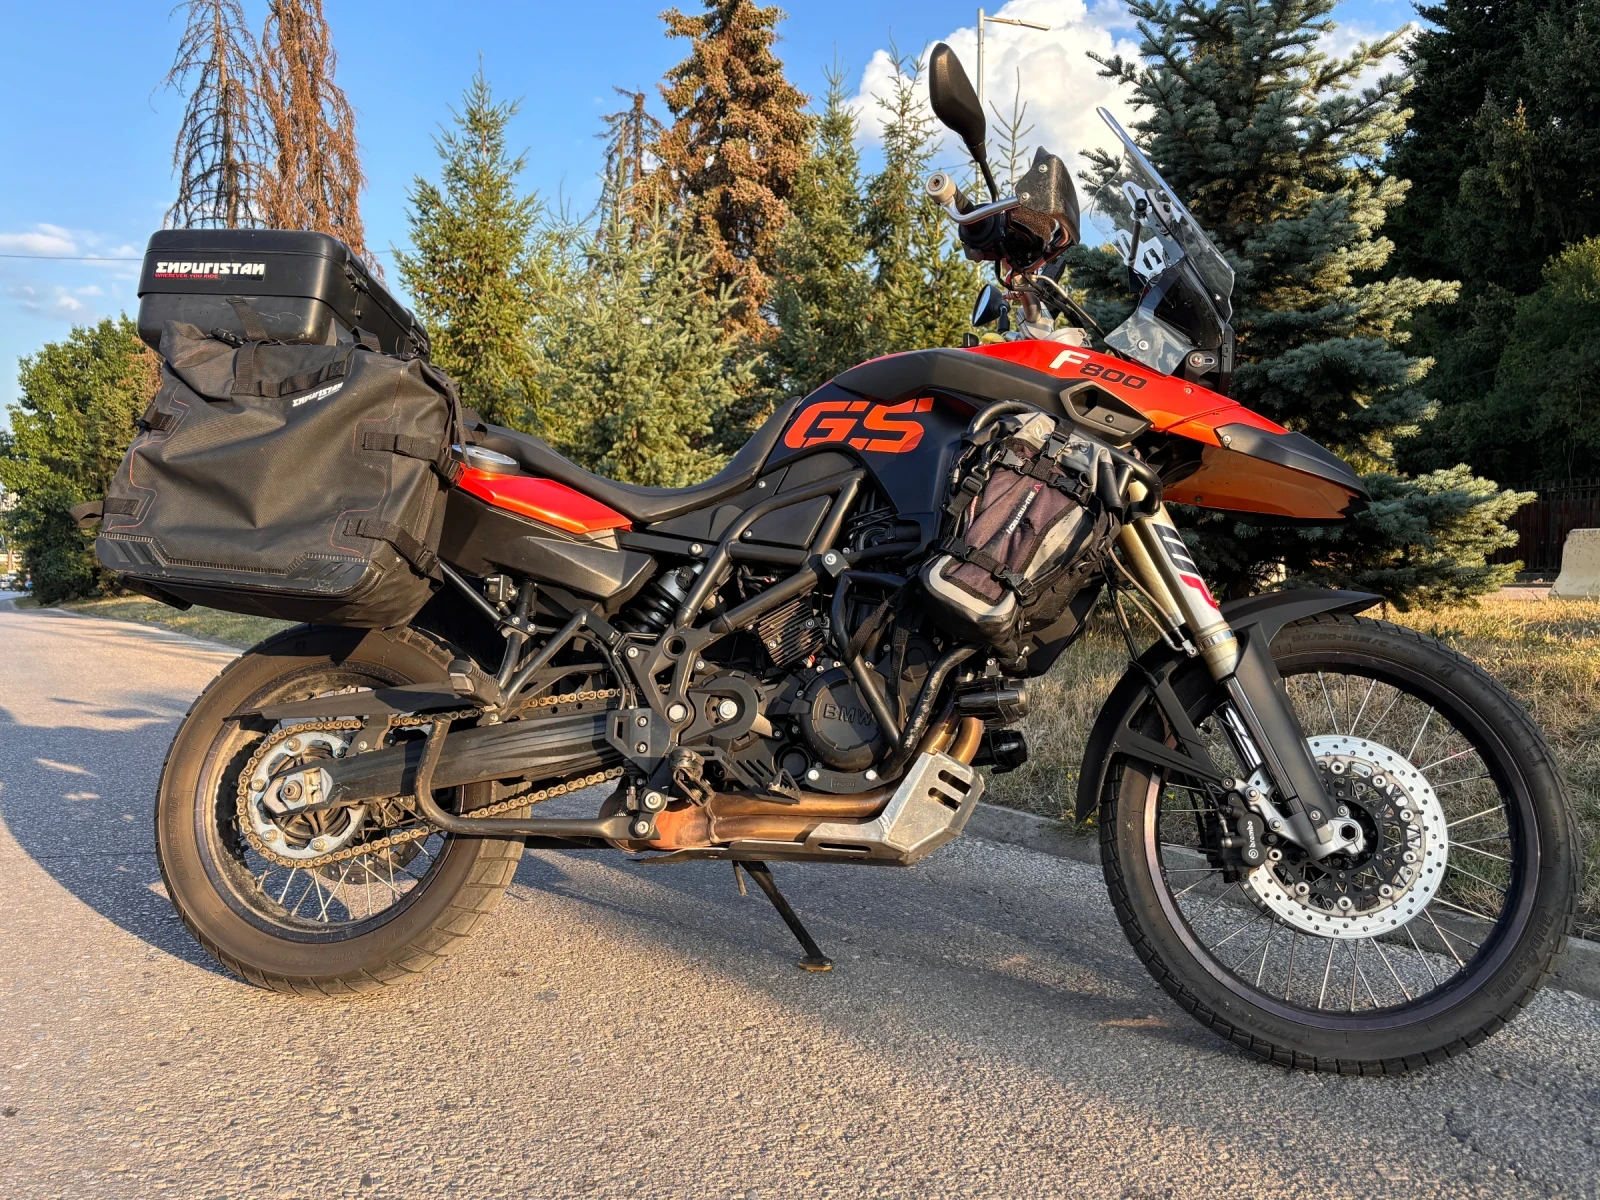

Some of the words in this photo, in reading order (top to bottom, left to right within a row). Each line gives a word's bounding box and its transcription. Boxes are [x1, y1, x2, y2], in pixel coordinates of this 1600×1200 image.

[155, 261, 265, 275] ENDURISTAN
[784, 397, 934, 453] GS
[823, 703, 874, 726] BMW
[1246, 820, 1257, 848] brembo
